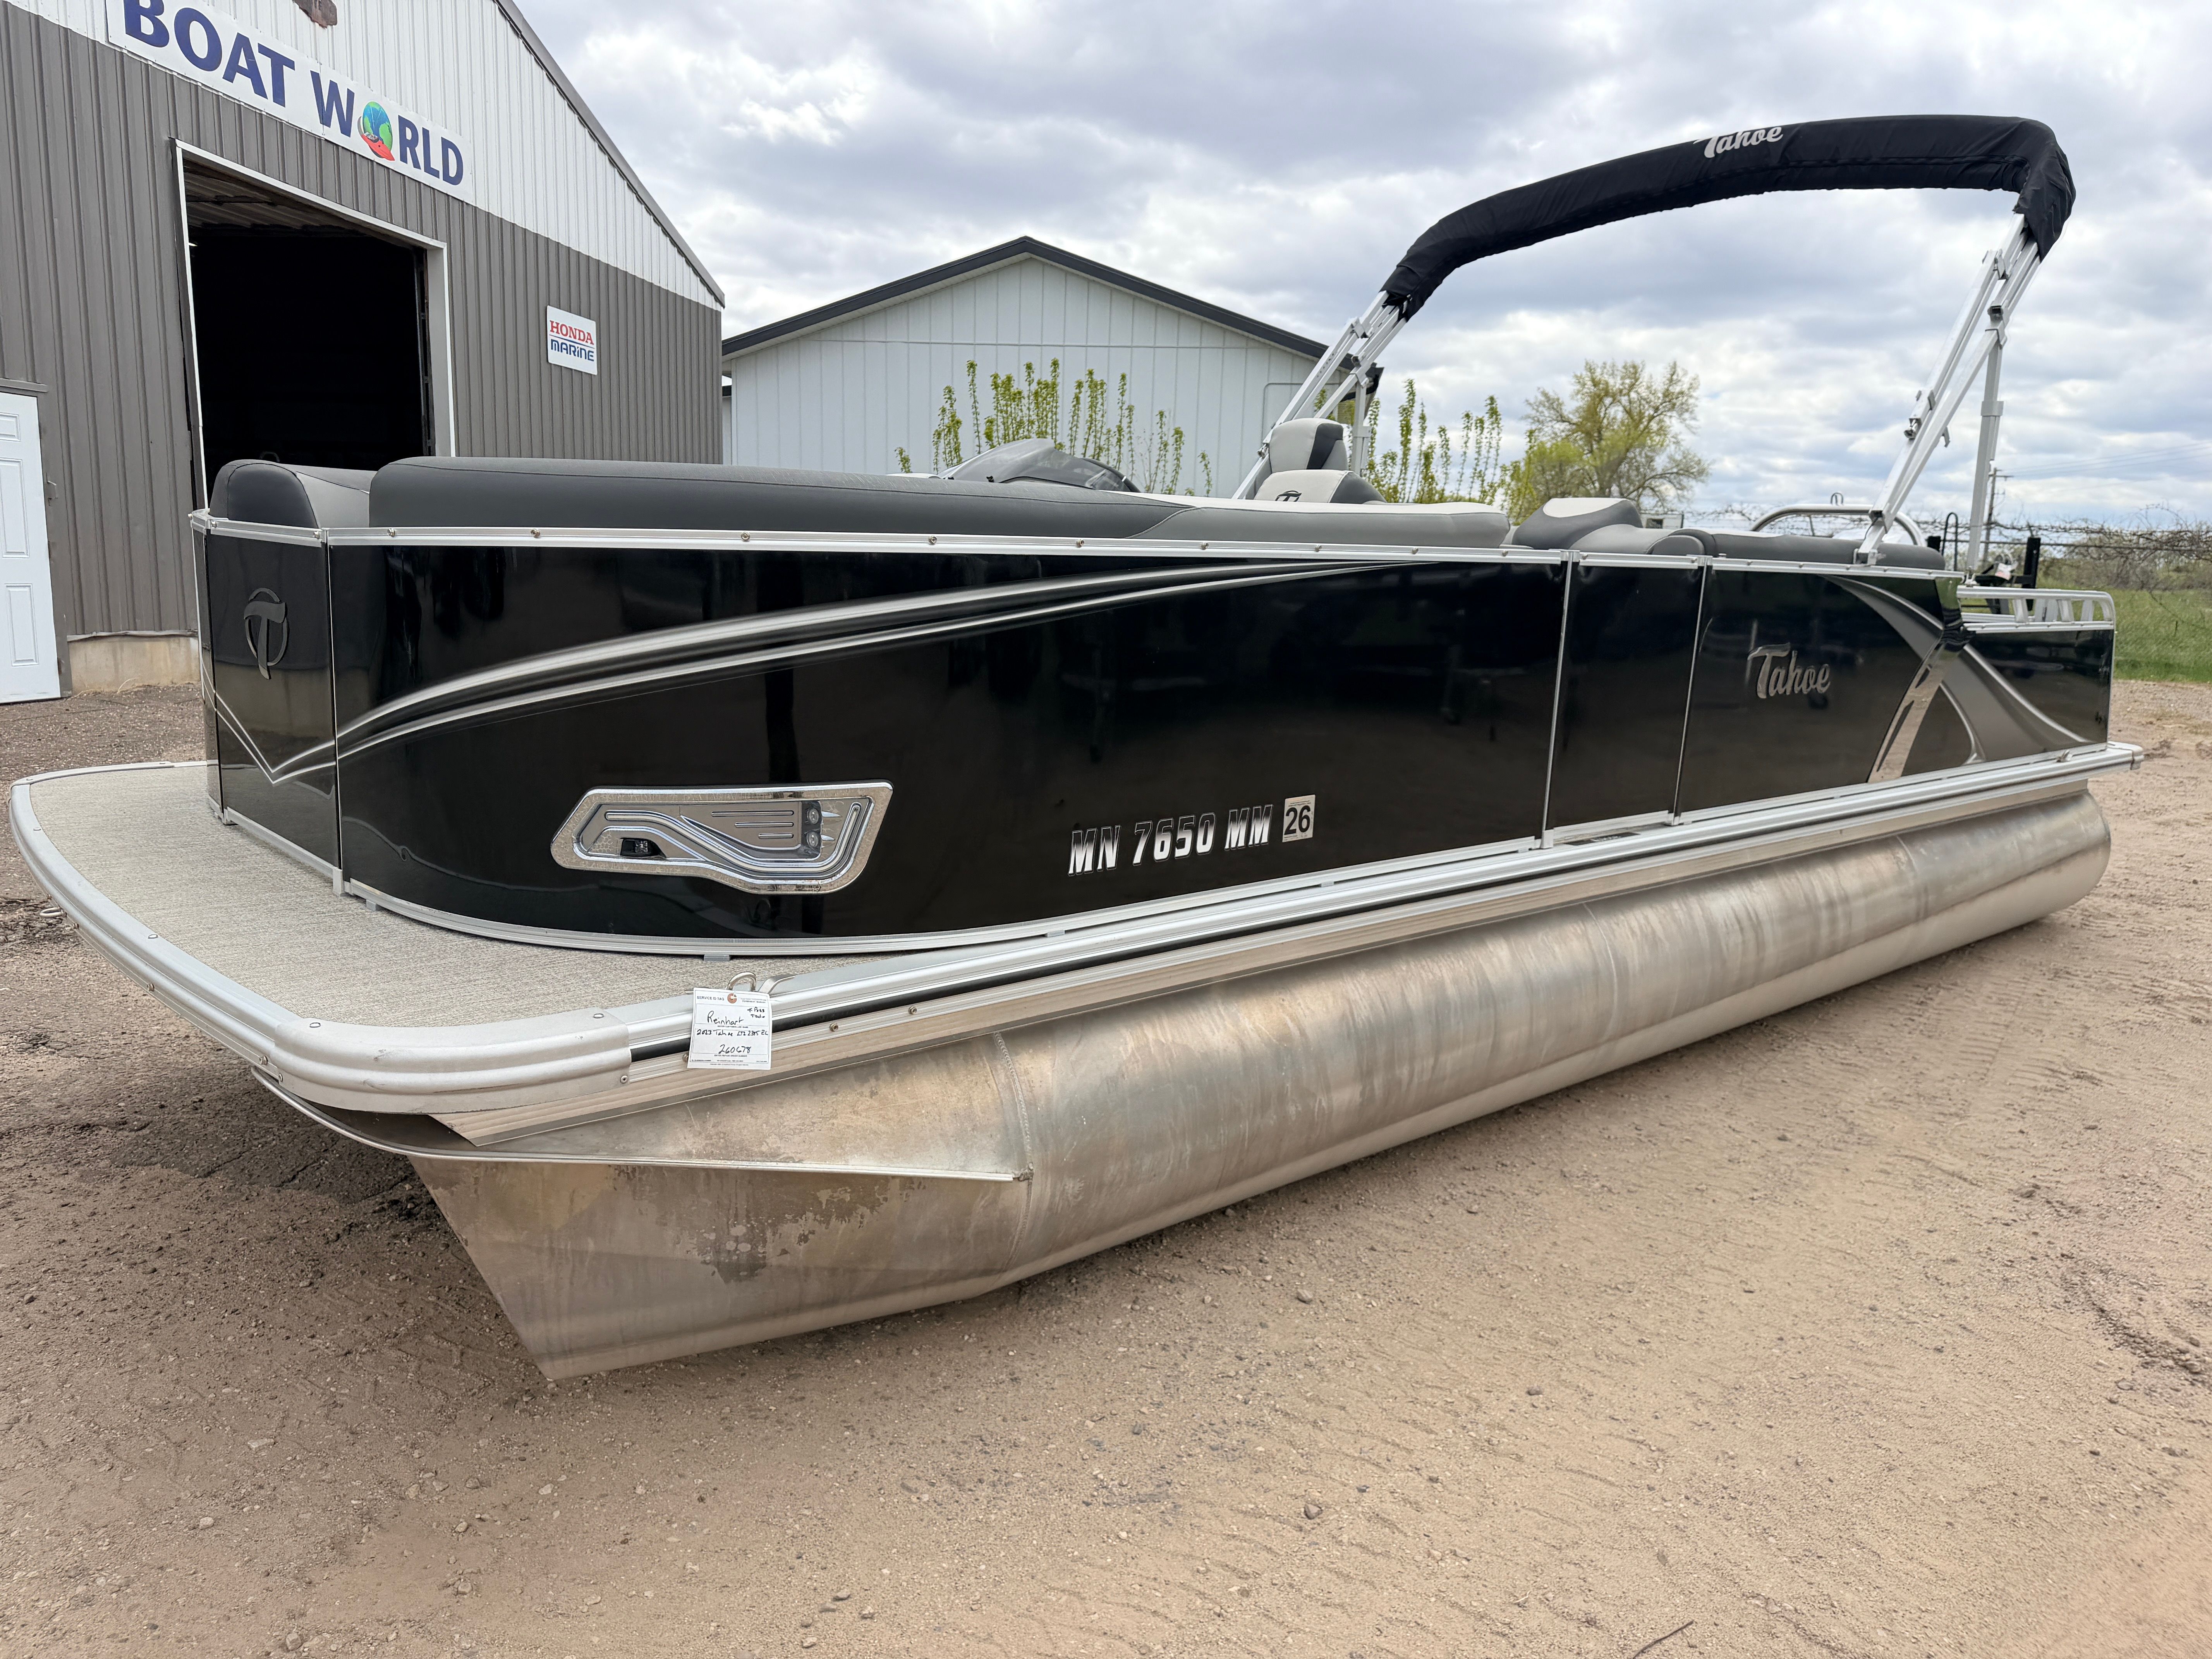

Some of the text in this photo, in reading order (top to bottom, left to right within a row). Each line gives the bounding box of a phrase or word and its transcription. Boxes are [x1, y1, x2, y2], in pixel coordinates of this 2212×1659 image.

[124, 0, 295, 108] BOAT
[1693, 127, 1783, 158] Tahoe
[550, 320, 594, 345] HONDA
[1747, 642, 1831, 699] Tahoe
[1068, 804, 1273, 876] MN 7650 MM
[1284, 805, 1310, 835] 26
